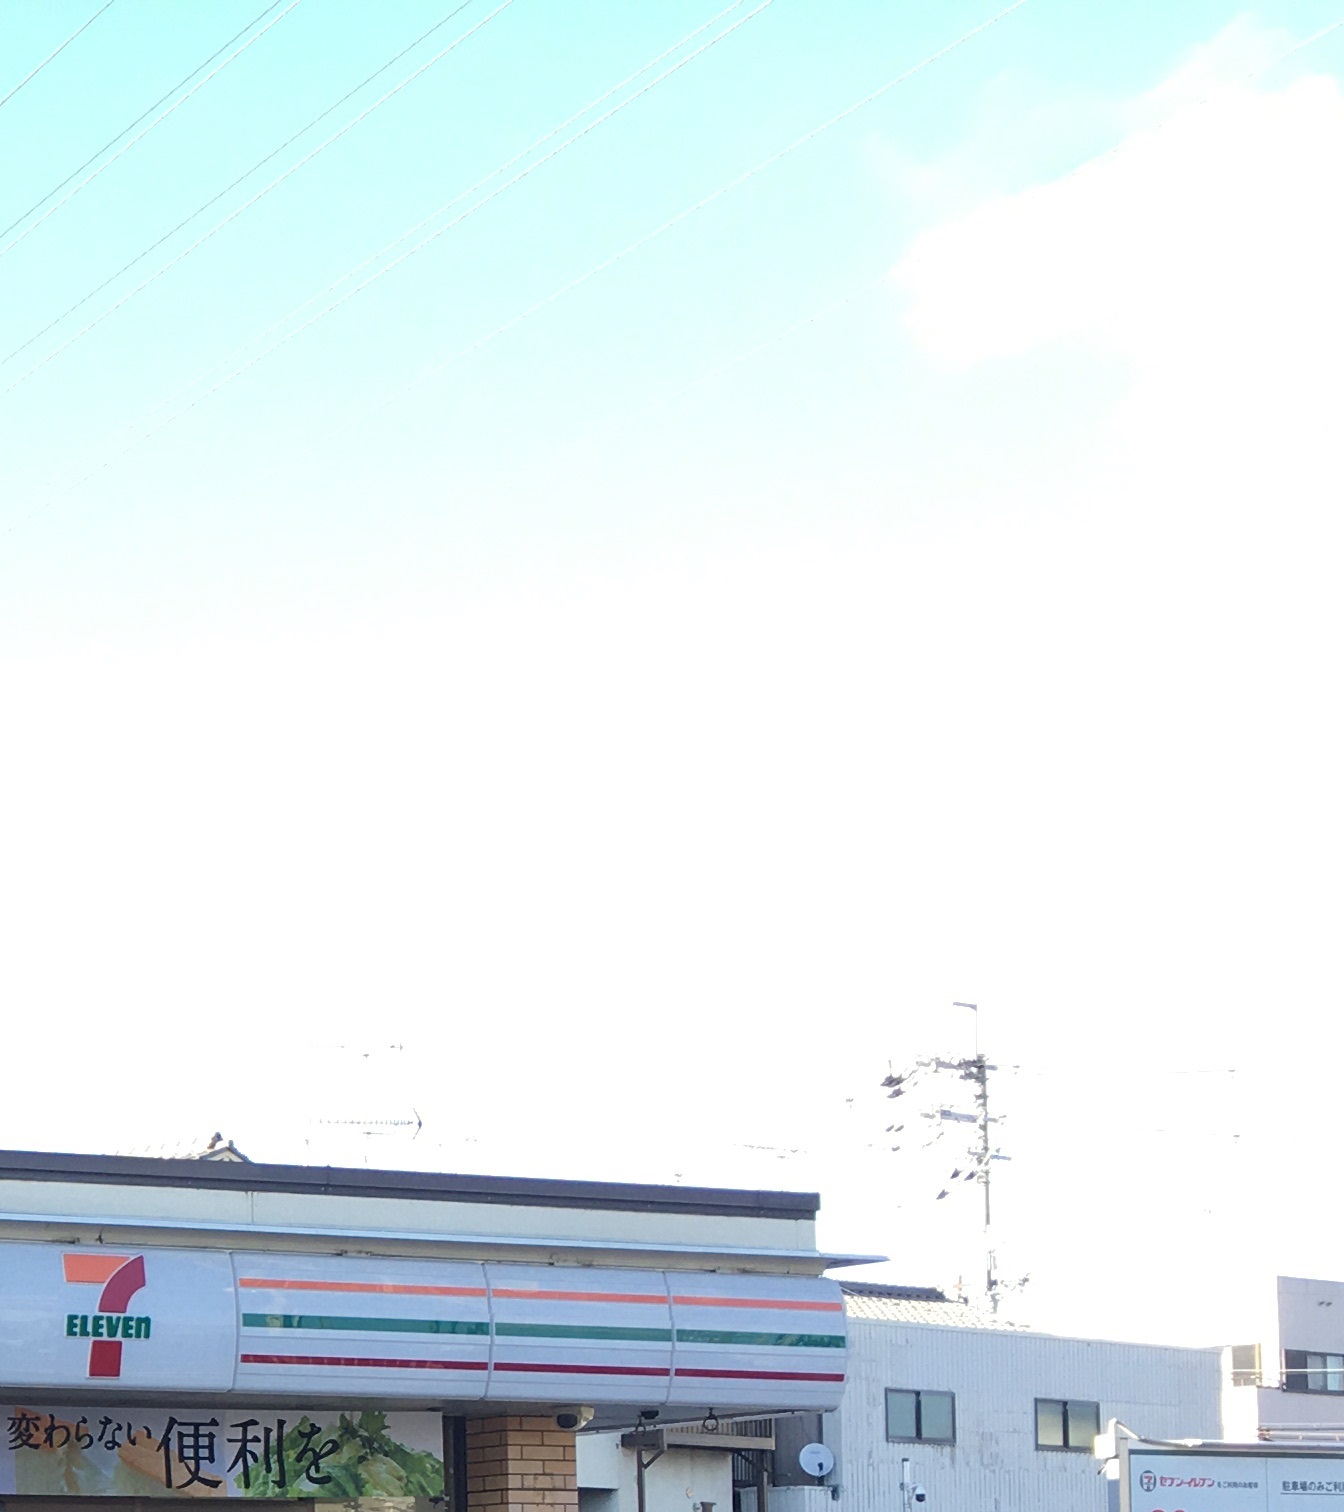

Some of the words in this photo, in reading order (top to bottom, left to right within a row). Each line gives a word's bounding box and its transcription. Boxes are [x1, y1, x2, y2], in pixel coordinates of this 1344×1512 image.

[63, 1253, 146, 1377] 7
[6, 1412, 341, 1489] 変わらない便利を
